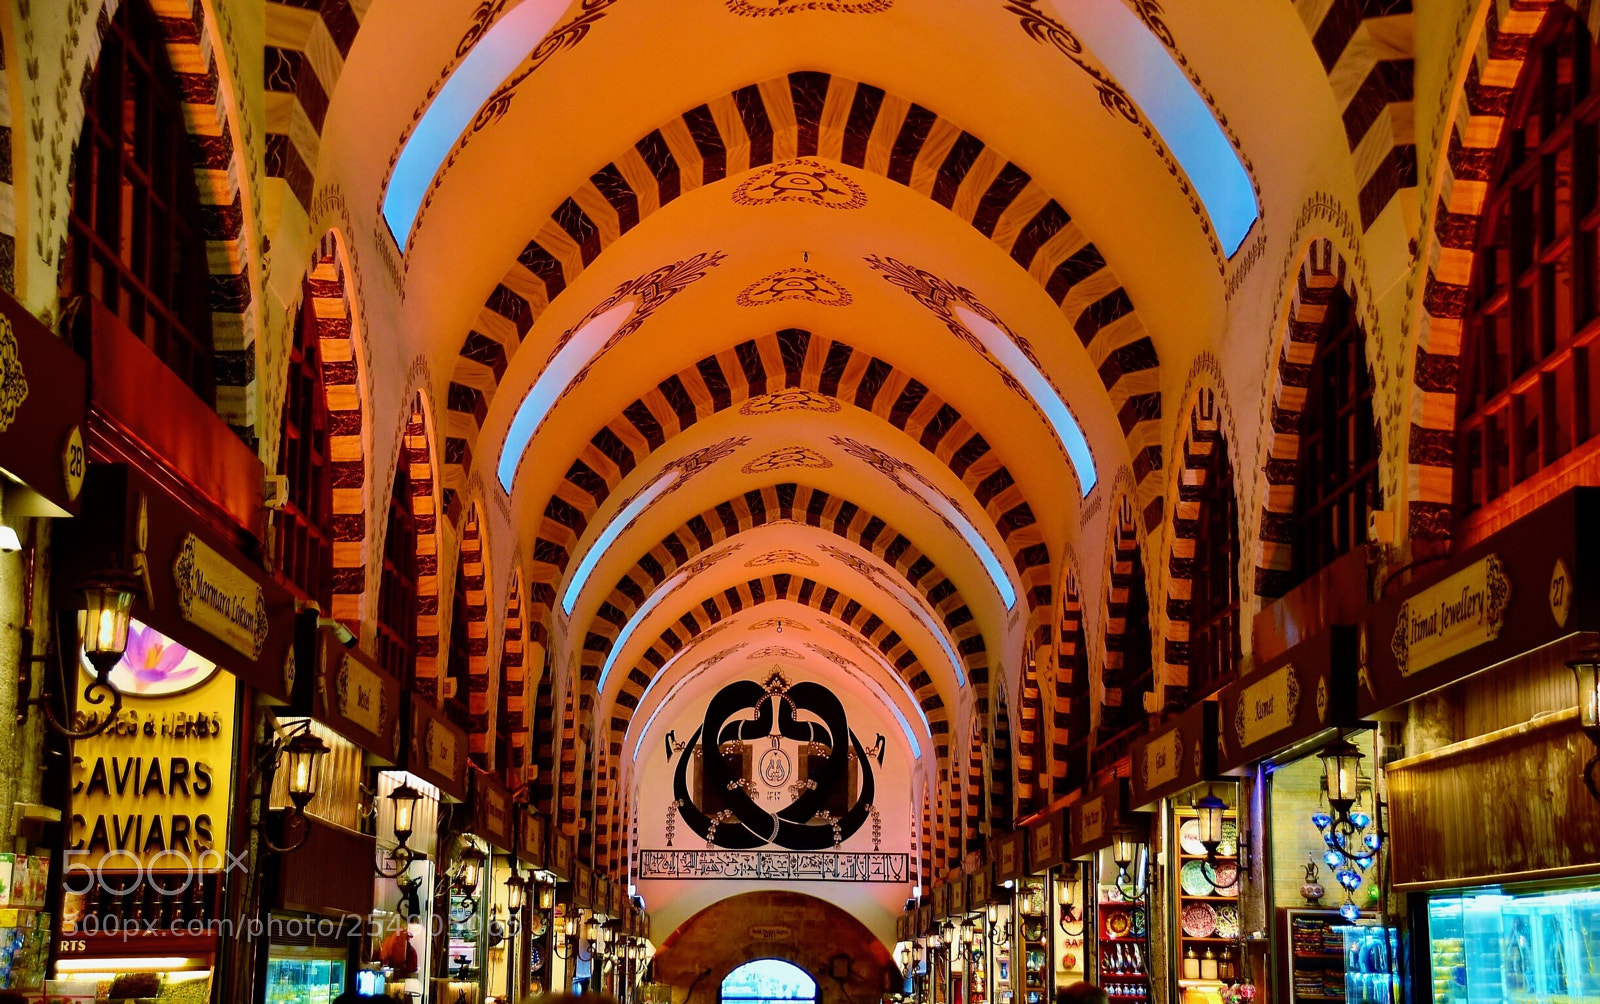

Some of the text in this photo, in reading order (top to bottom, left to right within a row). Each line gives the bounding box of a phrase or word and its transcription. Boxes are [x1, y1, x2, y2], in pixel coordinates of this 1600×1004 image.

[70, 444, 82, 478] 28
[193, 568, 254, 634] Marmara Lokum
[1438, 585, 1485, 637] Jewellery
[1552, 576, 1565, 607] 27
[73, 756, 213, 796] CAVIARS
[72, 814, 214, 854] CAVIARS
[60, 940, 86, 952] RTS
